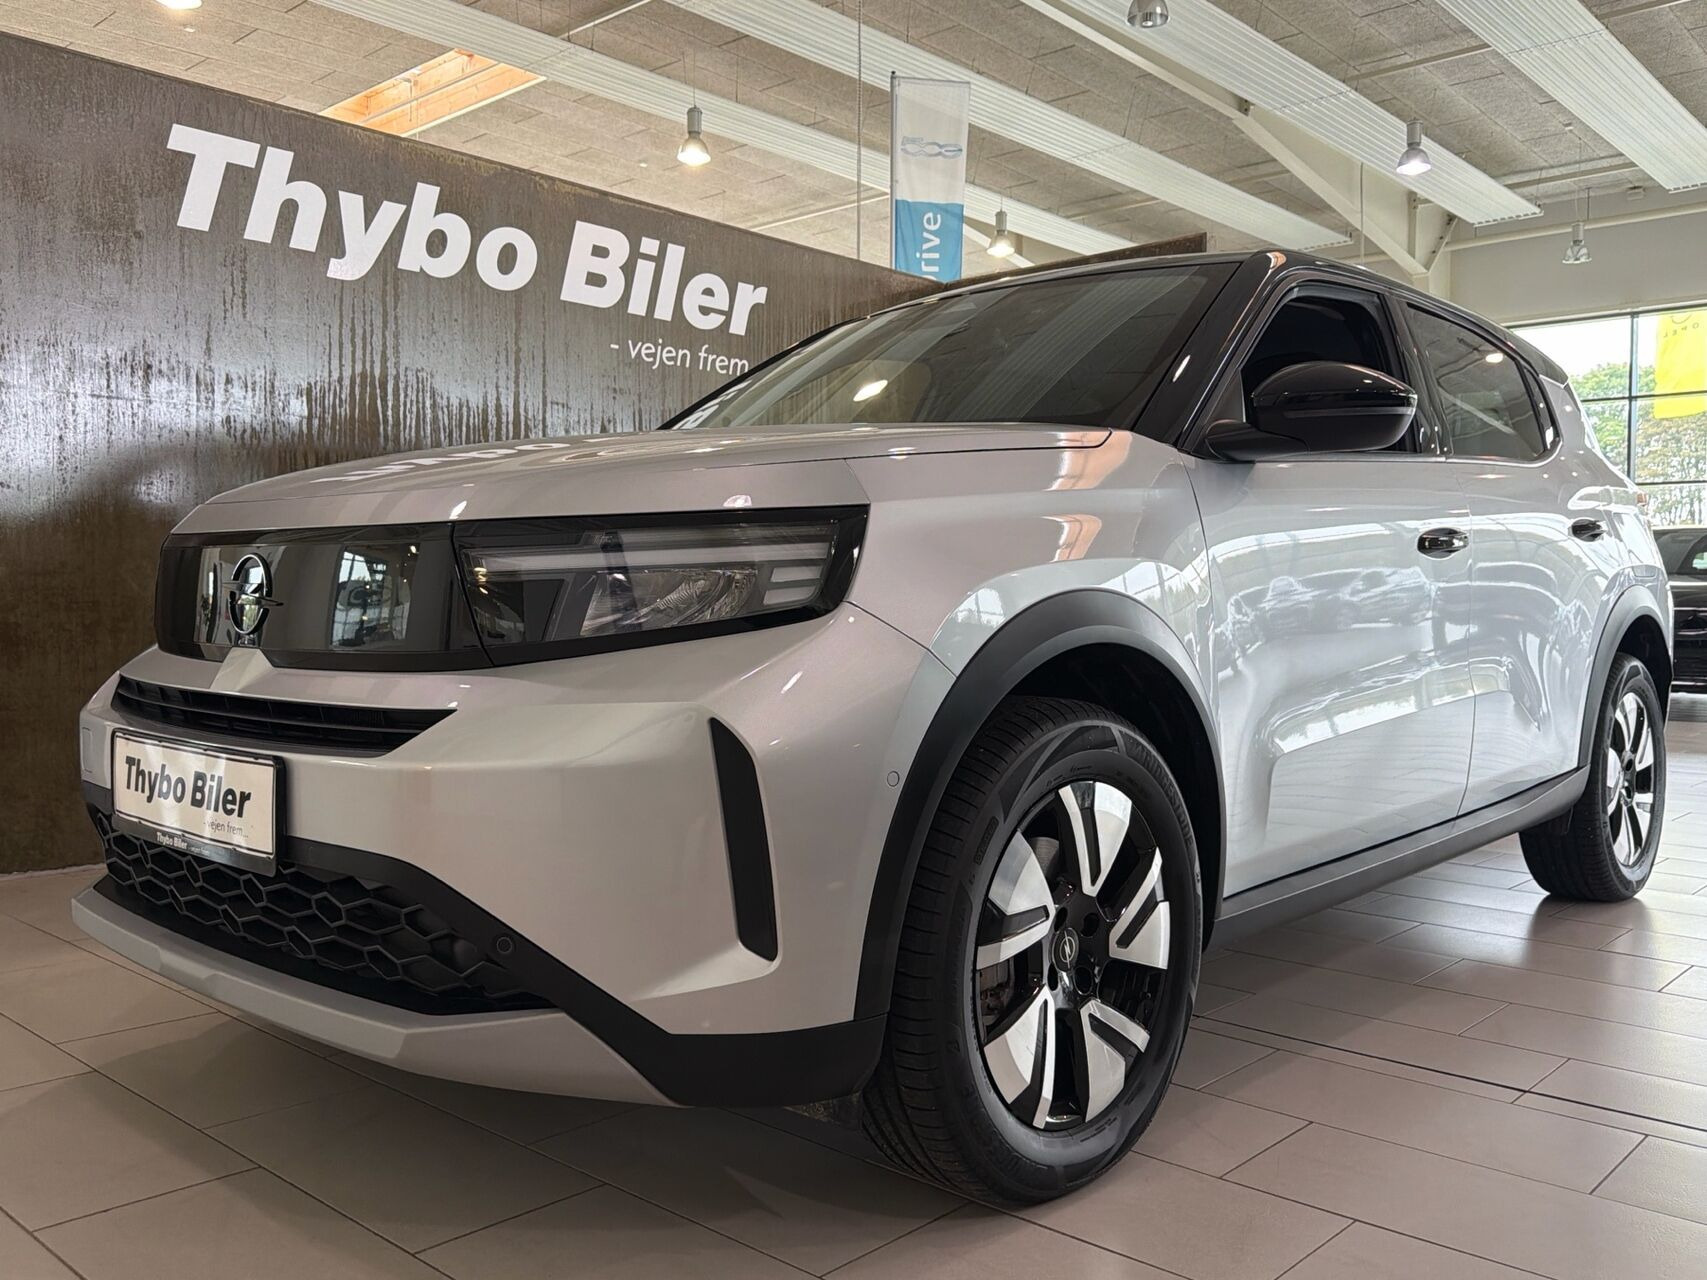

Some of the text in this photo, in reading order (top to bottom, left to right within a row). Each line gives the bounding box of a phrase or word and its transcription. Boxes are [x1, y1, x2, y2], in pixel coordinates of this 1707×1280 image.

[166, 123, 768, 336] Thybo Biler
[915, 211, 942, 281] rive
[628, 338, 691, 370] vejen
[698, 344, 749, 376] frem
[125, 755, 252, 818] Thybo Biler
